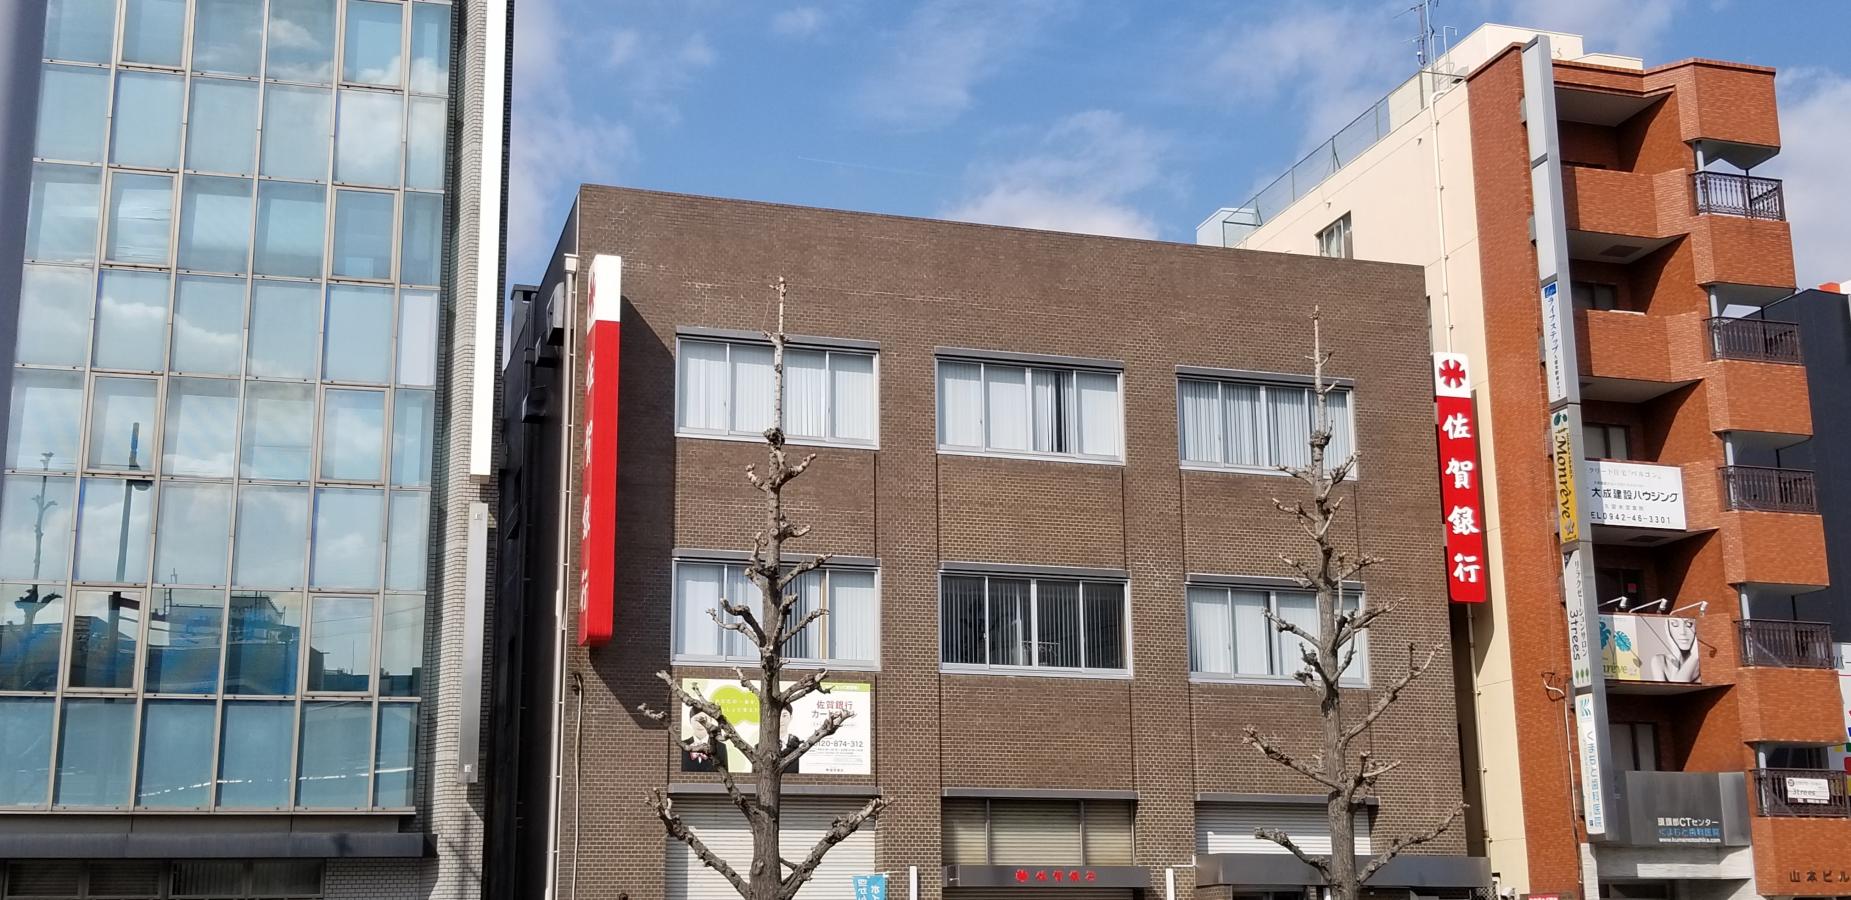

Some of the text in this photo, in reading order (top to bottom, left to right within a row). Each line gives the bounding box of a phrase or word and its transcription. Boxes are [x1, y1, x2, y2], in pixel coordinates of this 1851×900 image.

[1442, 412, 1480, 583] 佐賀銀行
[1591, 487, 1679, 503] 大成建設ハウジング
[1569, 609, 1581, 661] 3trees
[816, 700, 854, 710] 佐賀銀行
[812, 740, 864, 748] 120-874-312
[1789, 869, 1850, 883] 山本ビル
